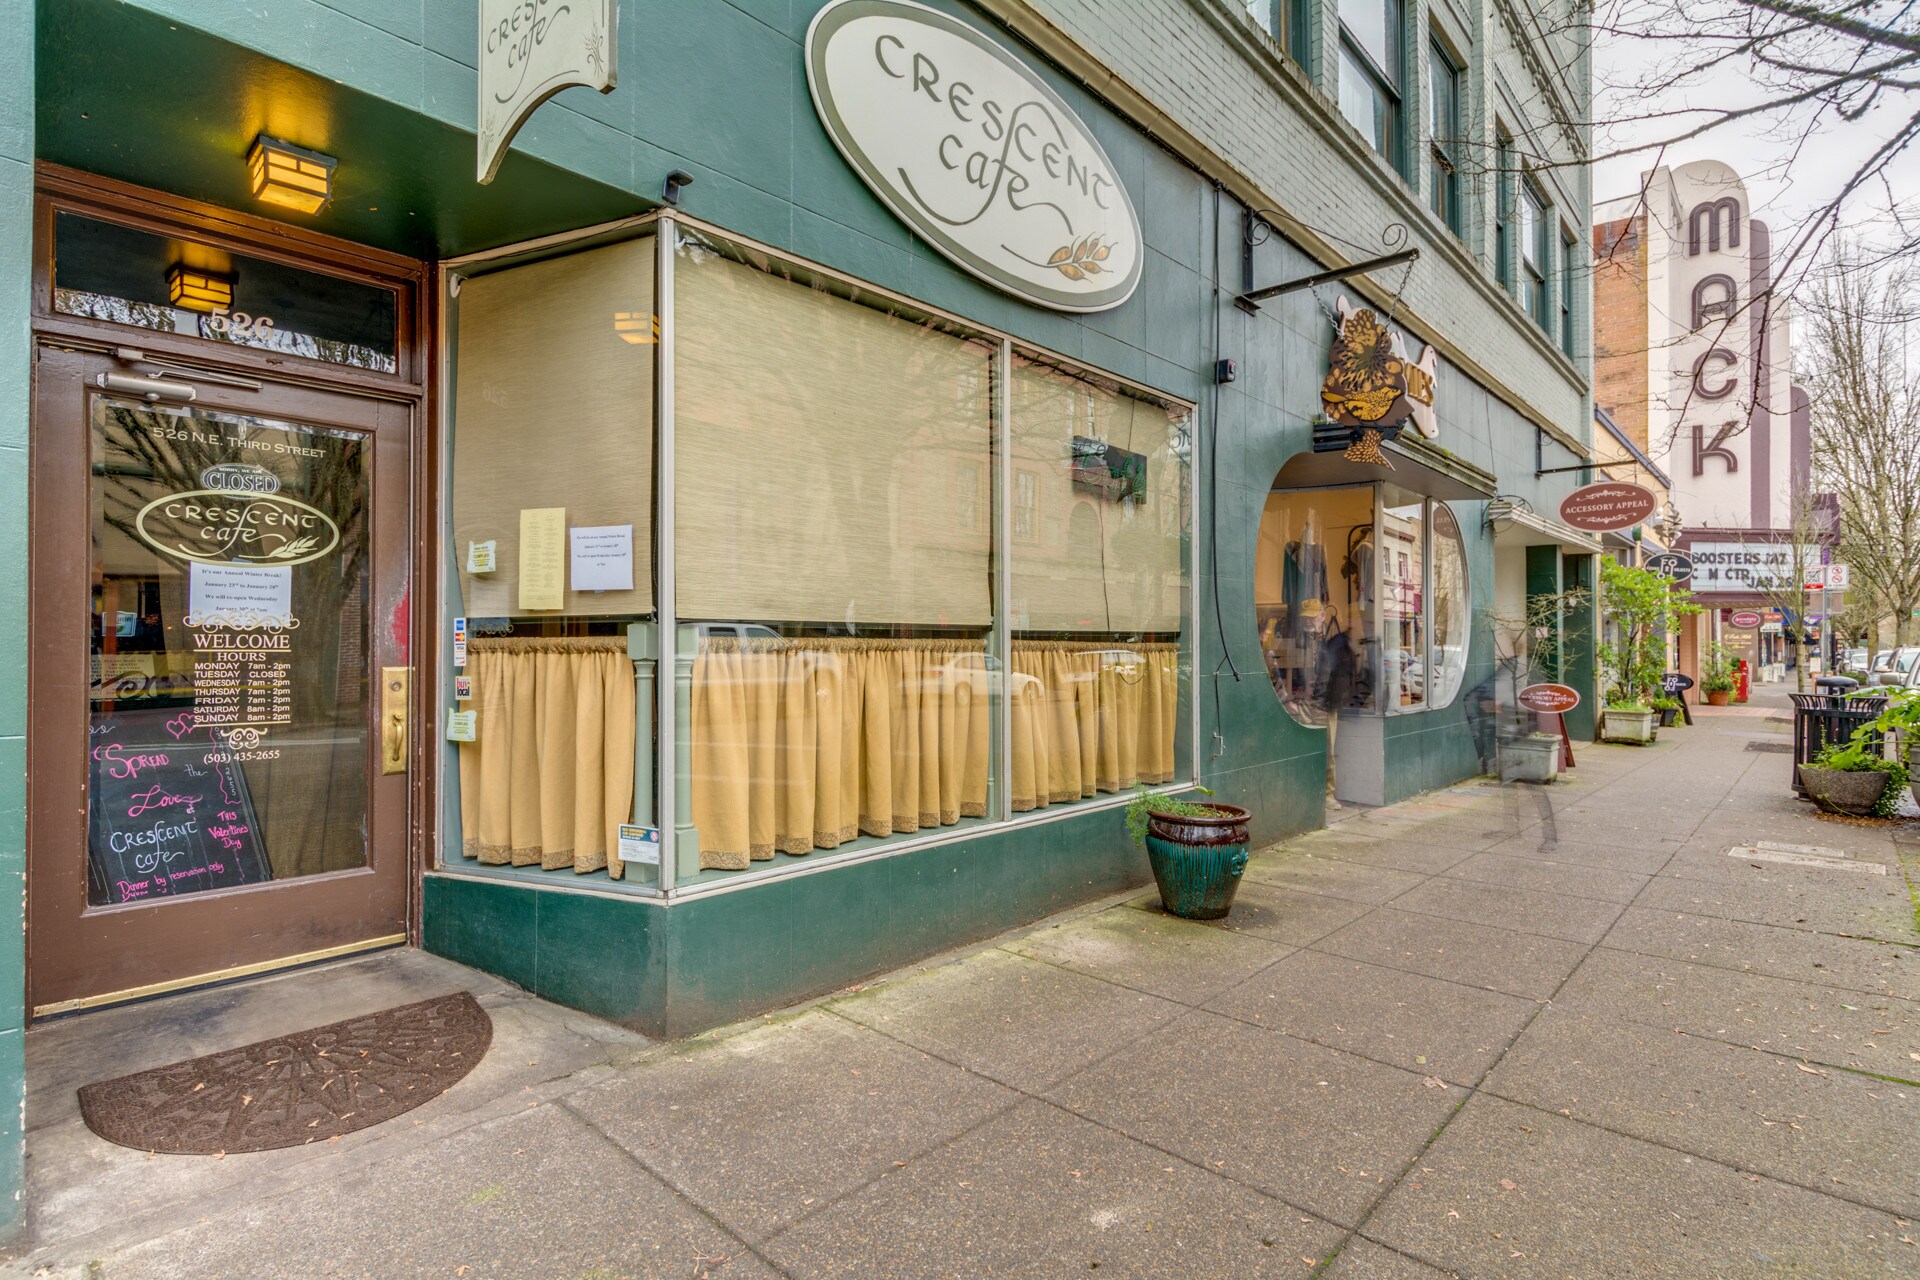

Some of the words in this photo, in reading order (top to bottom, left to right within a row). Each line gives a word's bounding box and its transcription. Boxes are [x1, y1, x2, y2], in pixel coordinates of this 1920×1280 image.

[487, 0, 548, 54] CRES
[875, 34, 1113, 209] CRESCENT
[210, 307, 274, 340] 526
[1689, 196, 1740, 476] MACK
[153, 427, 188, 441] 526
[192, 432, 223, 446] N.E.
[227, 437, 271, 451] THIRD
[274, 443, 326, 458] STREET
[207, 471, 278, 494] CLOSED
[1565, 503, 1614, 514] ACCESSORY
[1616, 500, 1649, 510] APPEAL
[165, 504, 318, 529] CRESCENT
[1692, 552, 1761, 565] BOOSTERS
[1708, 568, 1719, 580] M
[1725, 568, 1750, 580] CTR
[193, 634, 291, 649] WELCOME
[217, 652, 266, 661] HOURS
[194, 679, 240, 687] WEDNESDAY
[272, 679, 290, 687] 2pm
[457, 677, 468, 689] buy
[194, 688, 240, 696] THURSDAY
[457, 687, 470, 697] local
[195, 697, 240, 705] FRIDAY
[272, 696, 291, 704] 2pm
[193, 705, 240, 714] SATURDAY
[194, 714, 239, 723] SUNDAY
[272, 713, 290, 721] 2pm
[203, 753, 231, 765] (503)
[233, 750, 280, 761] 435-2655
[184, 764, 208, 777] the
[128, 785, 190, 817] Love
[217, 811, 238, 821] THIS
[110, 821, 198, 853] CRESCENT
[221, 837, 242, 849] Day
[116, 880, 149, 895] Dinner
[154, 875, 167, 886] by
[170, 867, 207, 880] reservation
[209, 861, 225, 873] only
